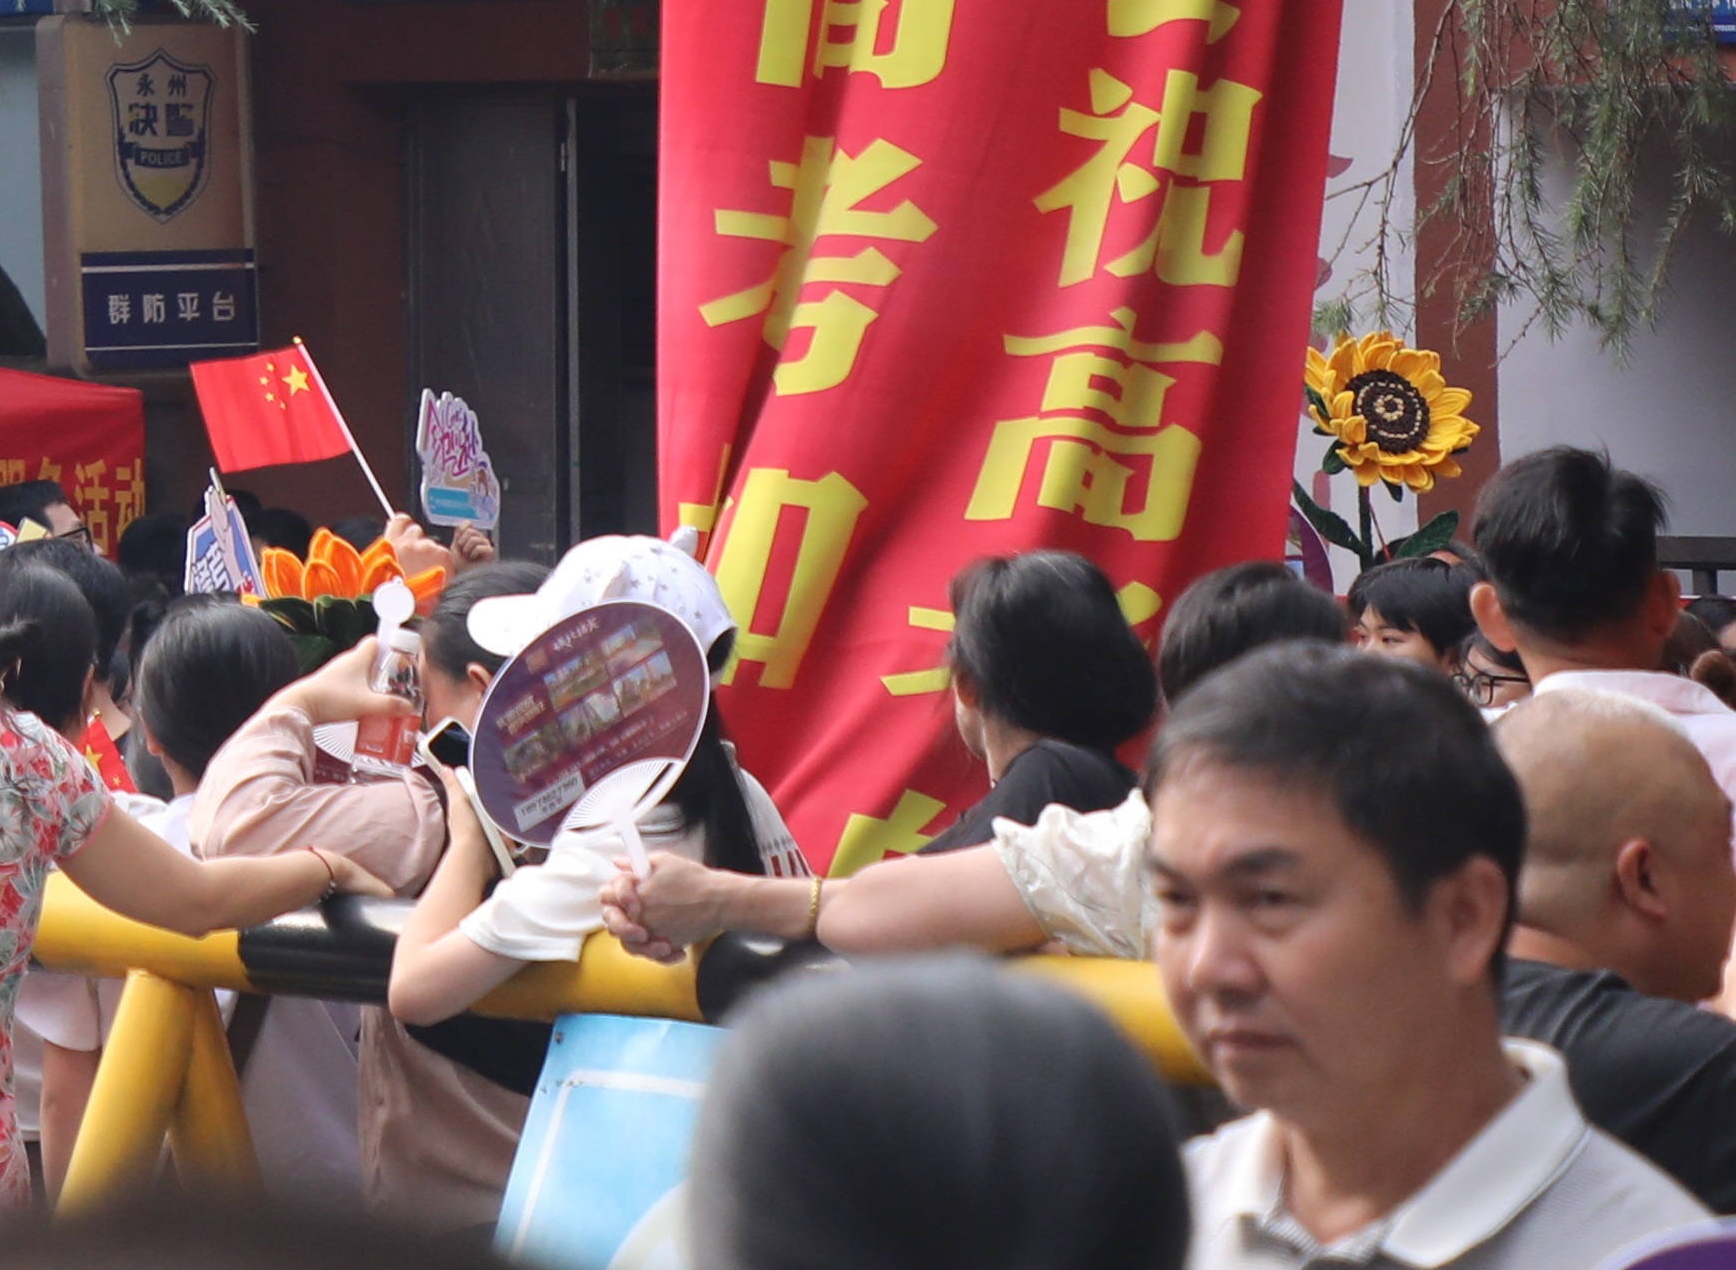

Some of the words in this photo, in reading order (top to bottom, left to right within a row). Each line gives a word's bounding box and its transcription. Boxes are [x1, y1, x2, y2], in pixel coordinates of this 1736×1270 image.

[136, 73, 188, 97] 永州
[139, 149, 183, 166] POLICE
[108, 291, 236, 325] 群防平台
